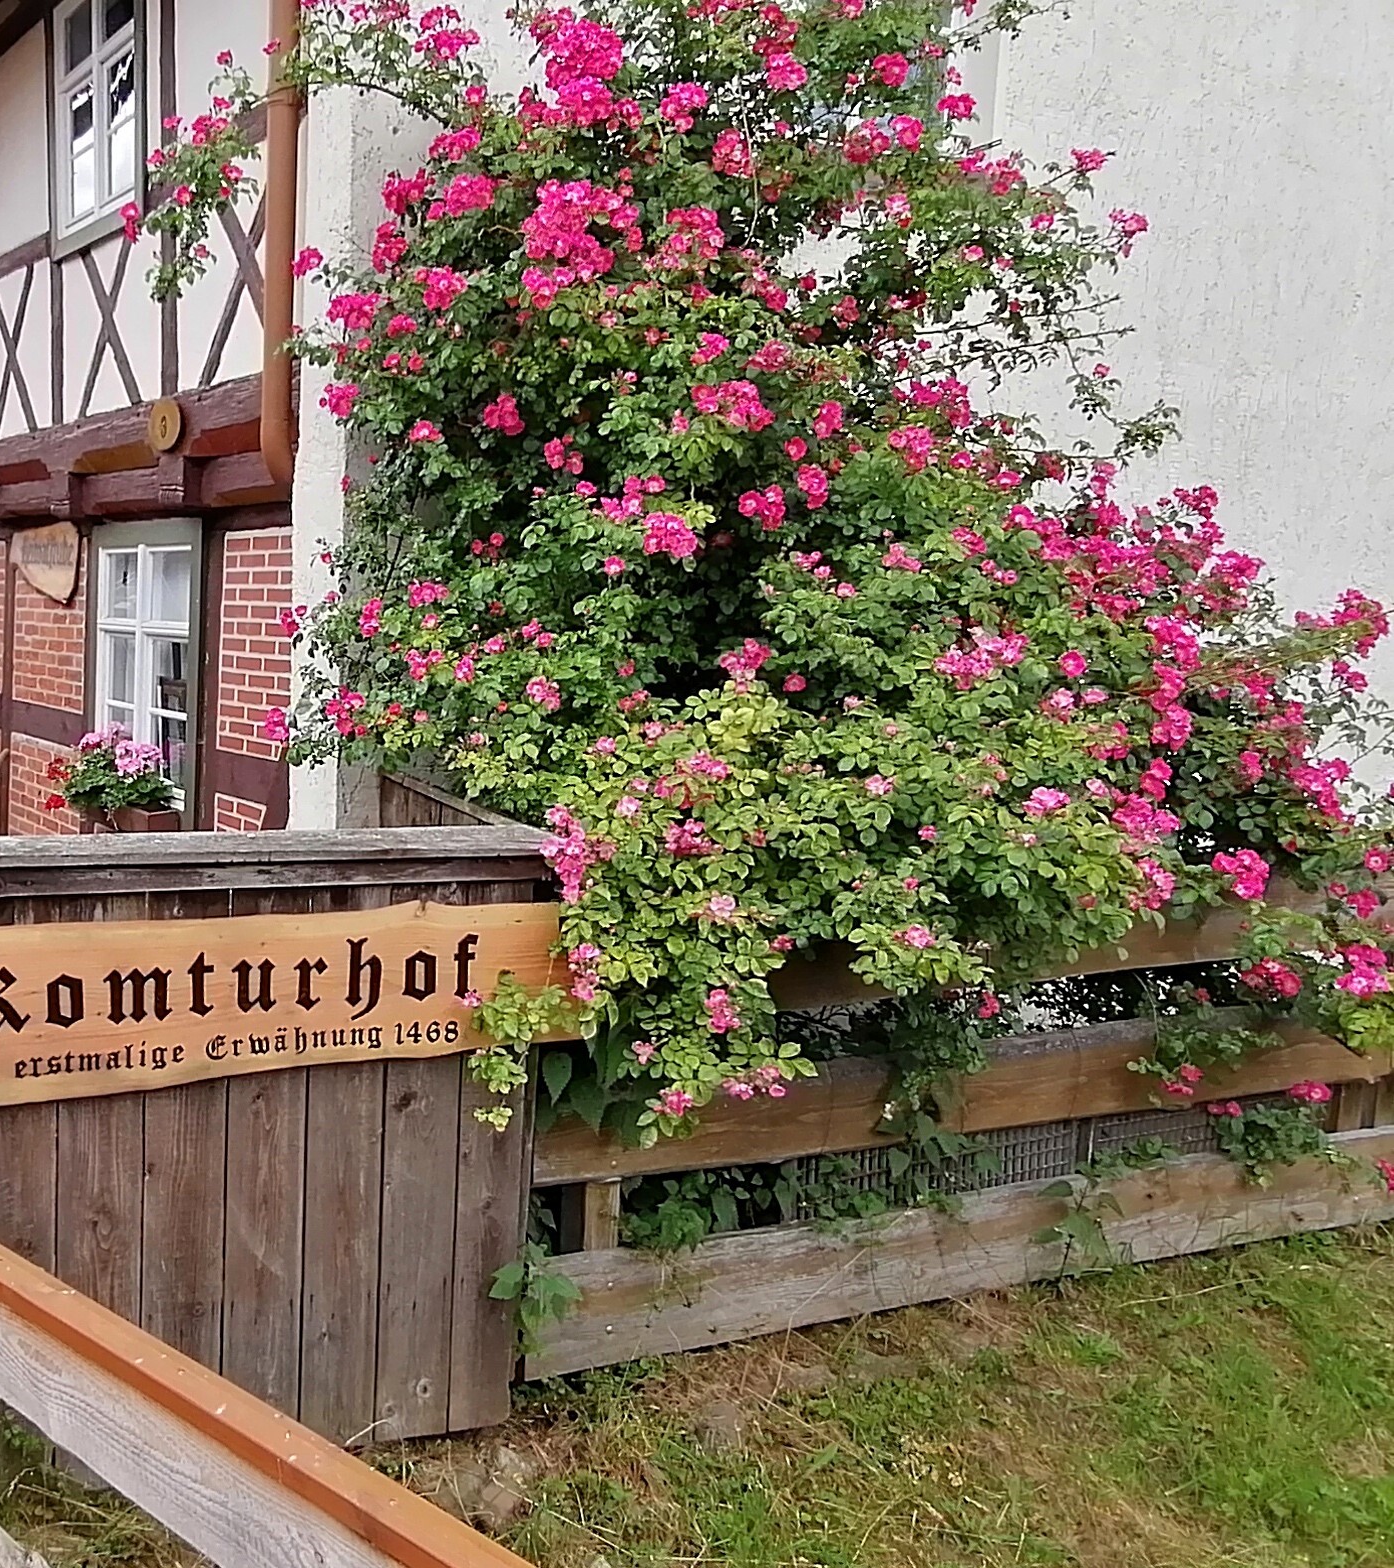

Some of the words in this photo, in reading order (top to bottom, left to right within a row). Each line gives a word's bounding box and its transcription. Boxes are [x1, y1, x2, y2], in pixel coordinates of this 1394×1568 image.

[14, 1040, 185, 1079] erstmalige
[205, 1025, 383, 1060] Erwähnung
[394, 1020, 459, 1045] 1468
